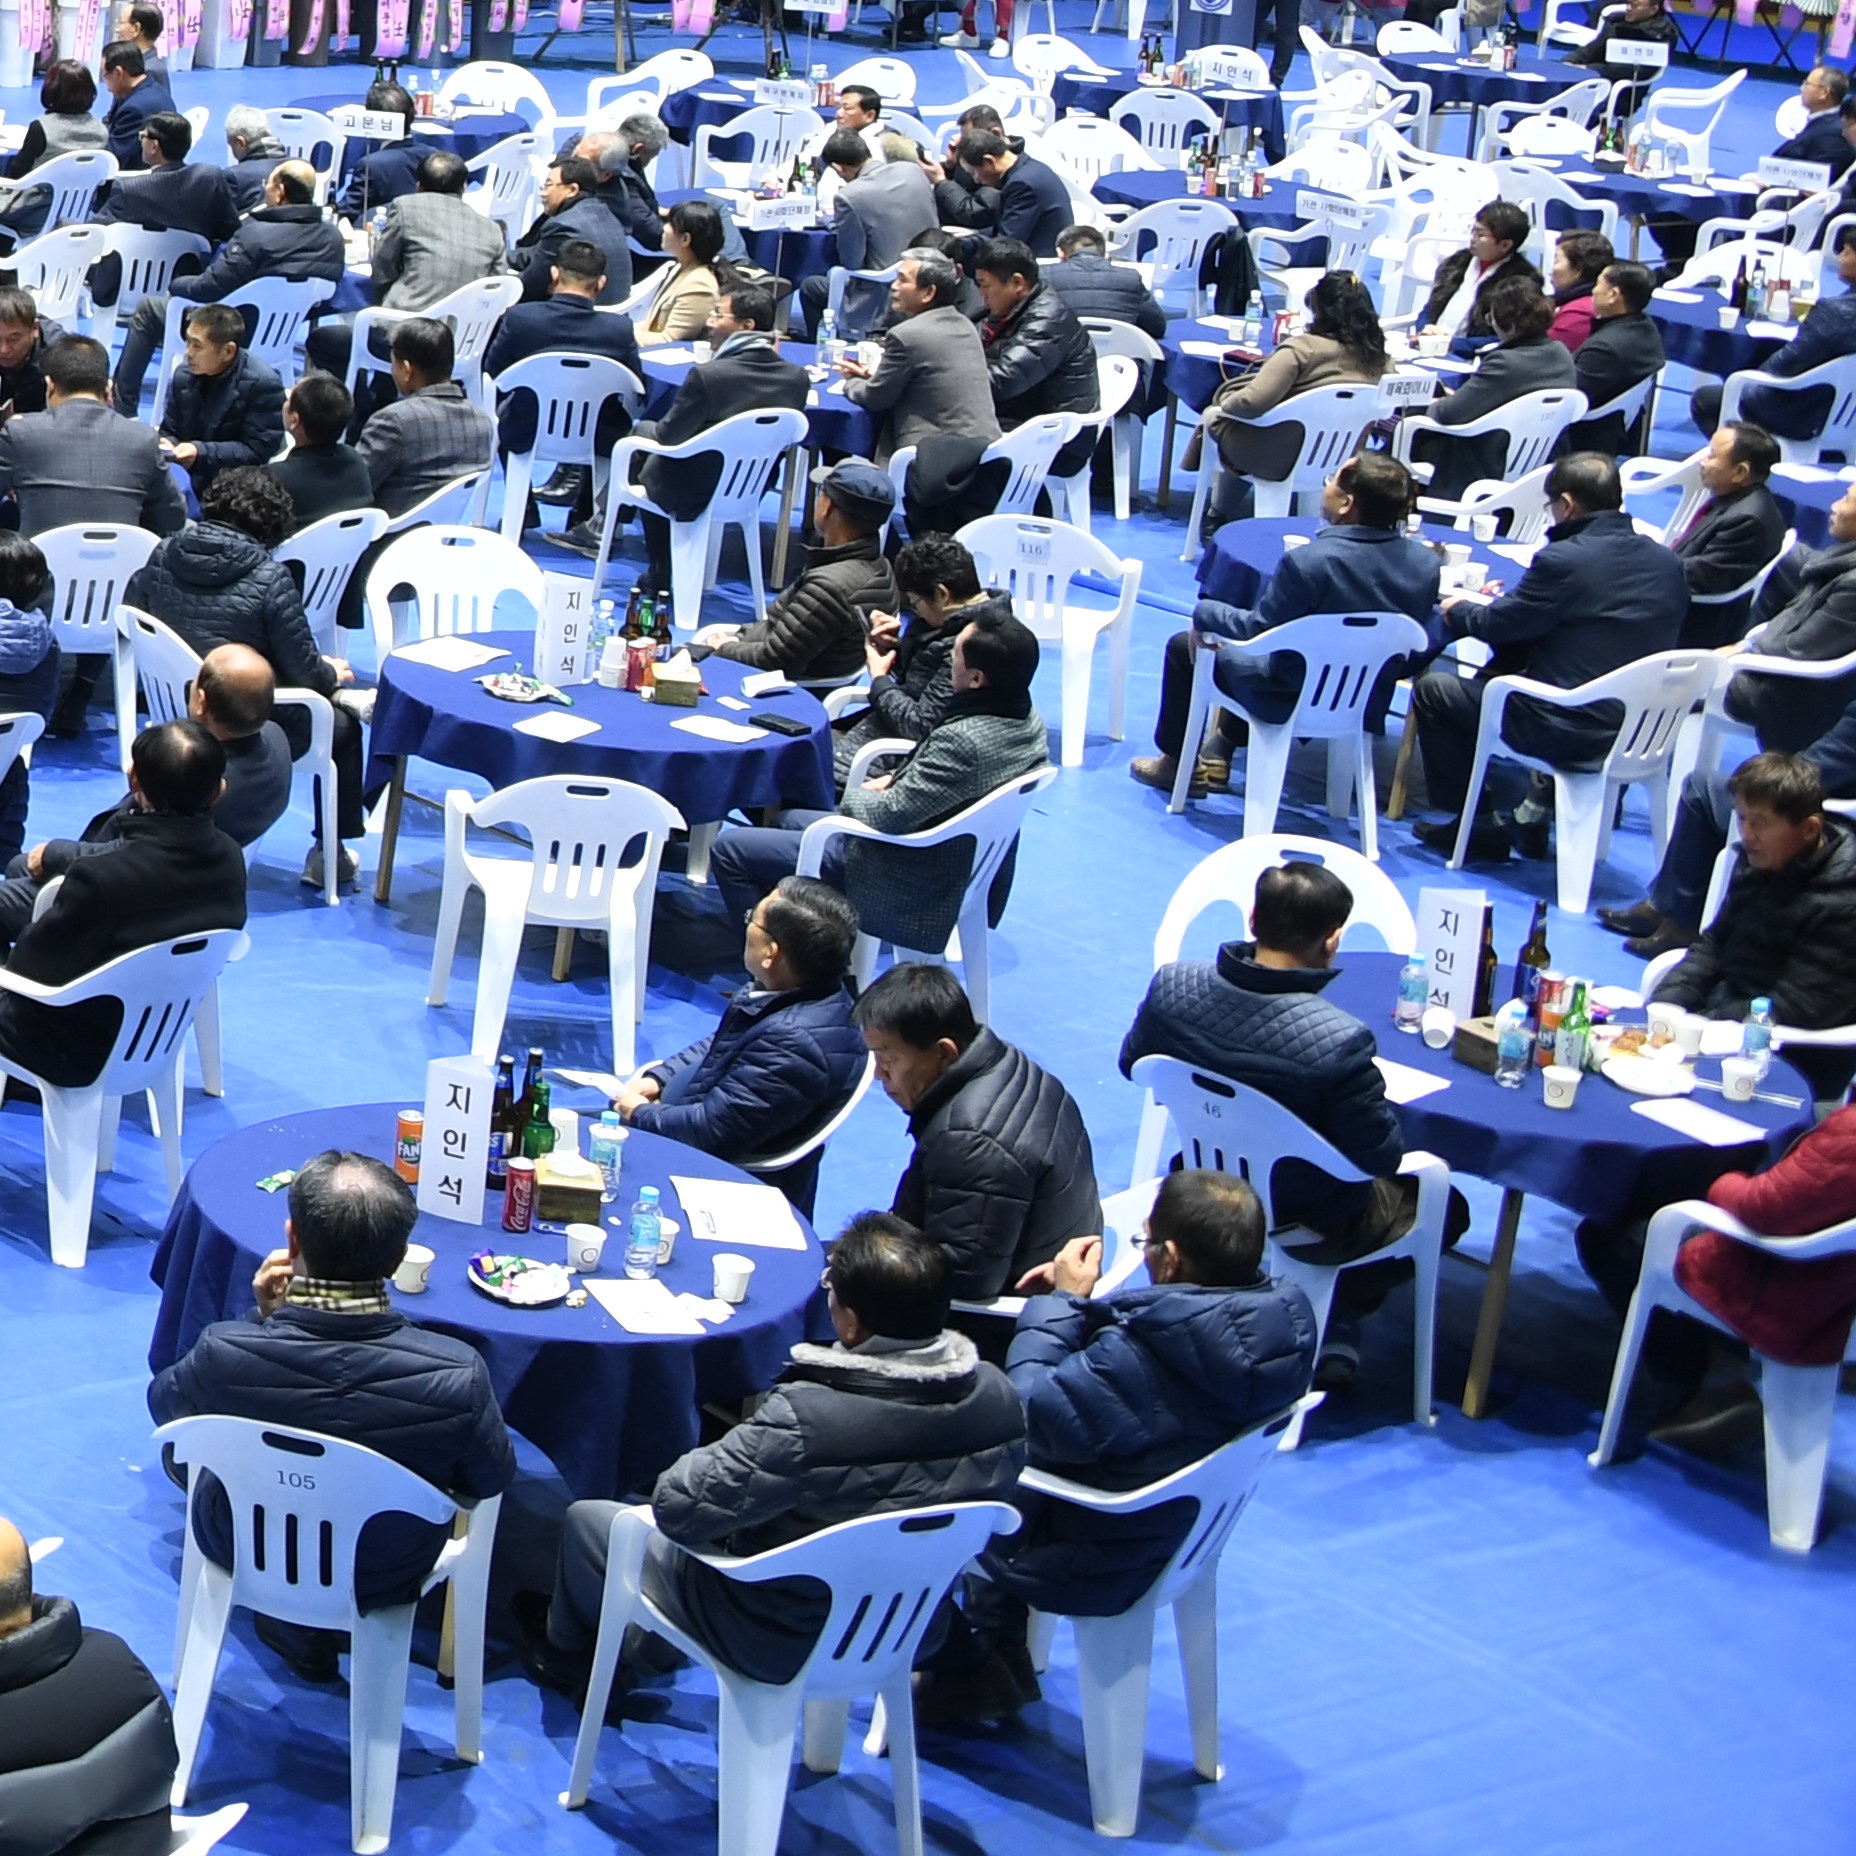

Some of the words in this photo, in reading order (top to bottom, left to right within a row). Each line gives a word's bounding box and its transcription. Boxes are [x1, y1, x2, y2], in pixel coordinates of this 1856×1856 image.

[1211, 61, 1254, 82] 지인석
[343, 114, 393, 131] 고문님
[1020, 543, 1043, 555] 116
[560, 591, 581, 675] 지인석
[1428, 908, 1459, 1009] 지인석
[1202, 1101, 1222, 1119] 46
[437, 1082, 471, 1206] 지인석
[277, 1469, 316, 1490] 105
